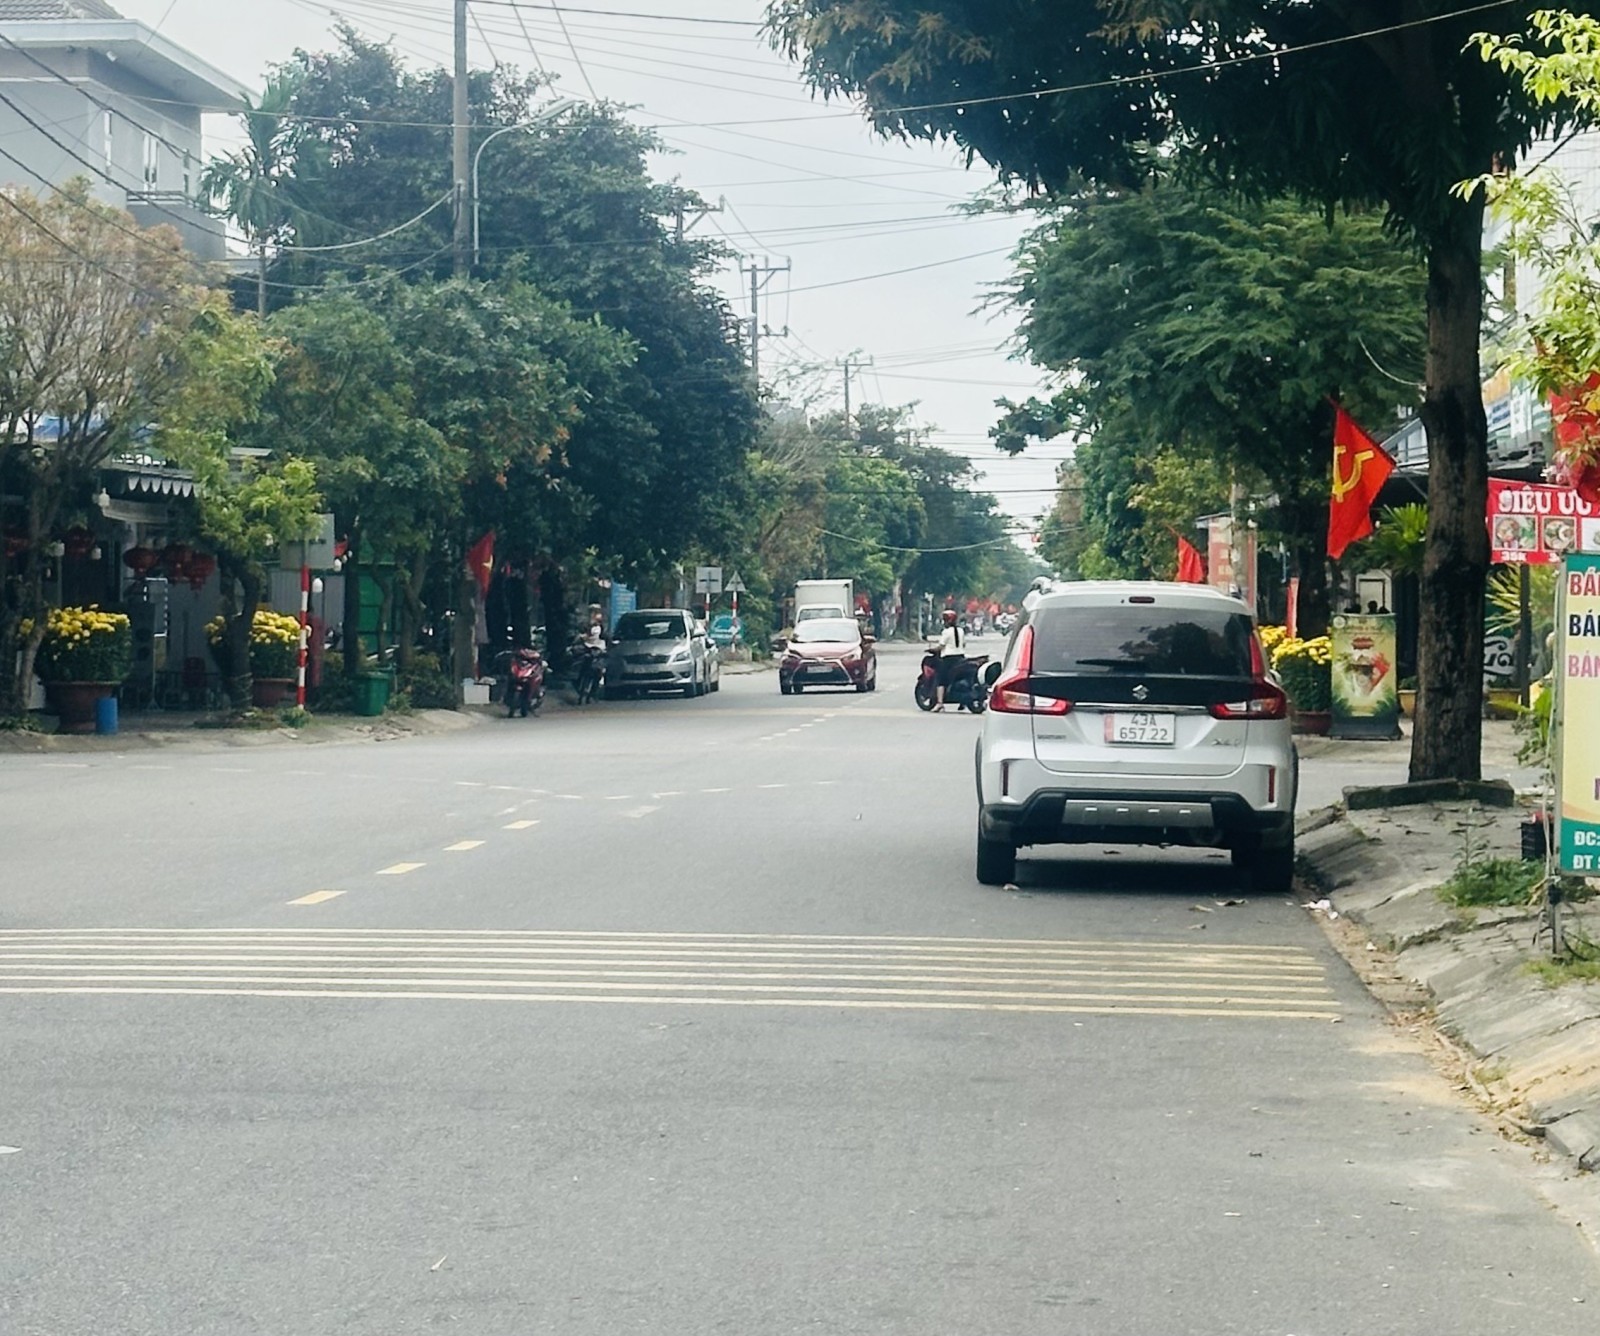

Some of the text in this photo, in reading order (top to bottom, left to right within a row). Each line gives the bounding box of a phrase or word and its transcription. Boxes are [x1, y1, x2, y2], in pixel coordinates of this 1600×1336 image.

[1568, 567, 1600, 597] BÁ
[1568, 608, 1600, 638] BÁ
[1131, 712, 1157, 727] 43A
[1119, 726, 1168, 741] 657.22
